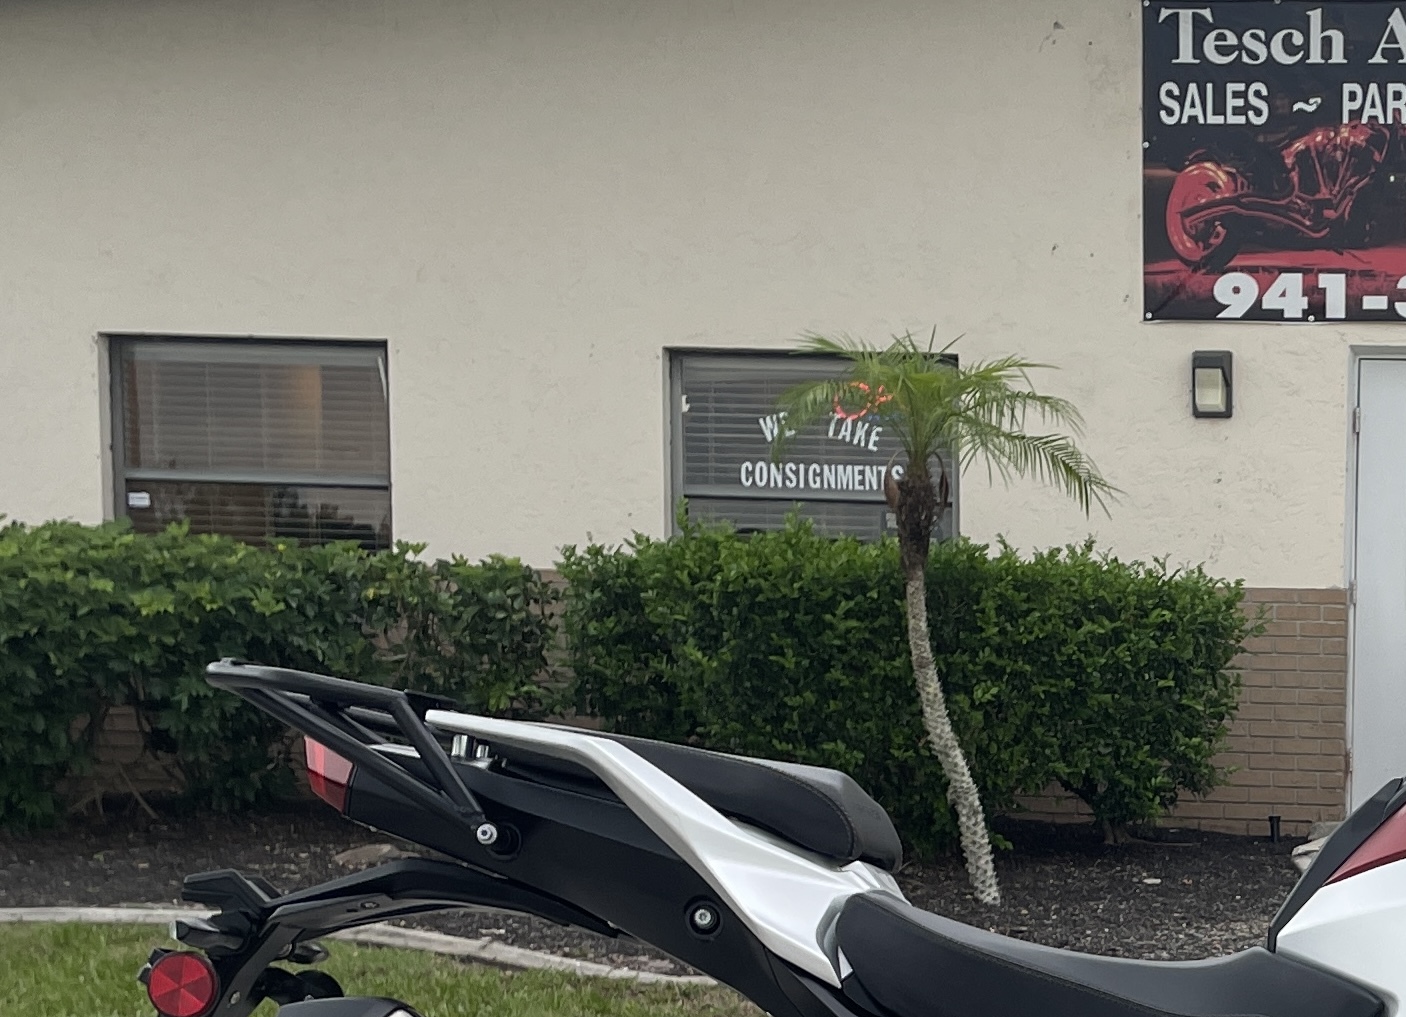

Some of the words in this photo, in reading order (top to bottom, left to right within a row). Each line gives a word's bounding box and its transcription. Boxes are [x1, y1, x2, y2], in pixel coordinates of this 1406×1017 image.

[1158, 7, 1348, 65] Tesch
[1159, 81, 1270, 125] SALES
[828, 411, 883, 452] TAKE
[740, 461, 904, 491] CONSIGNMENTS
